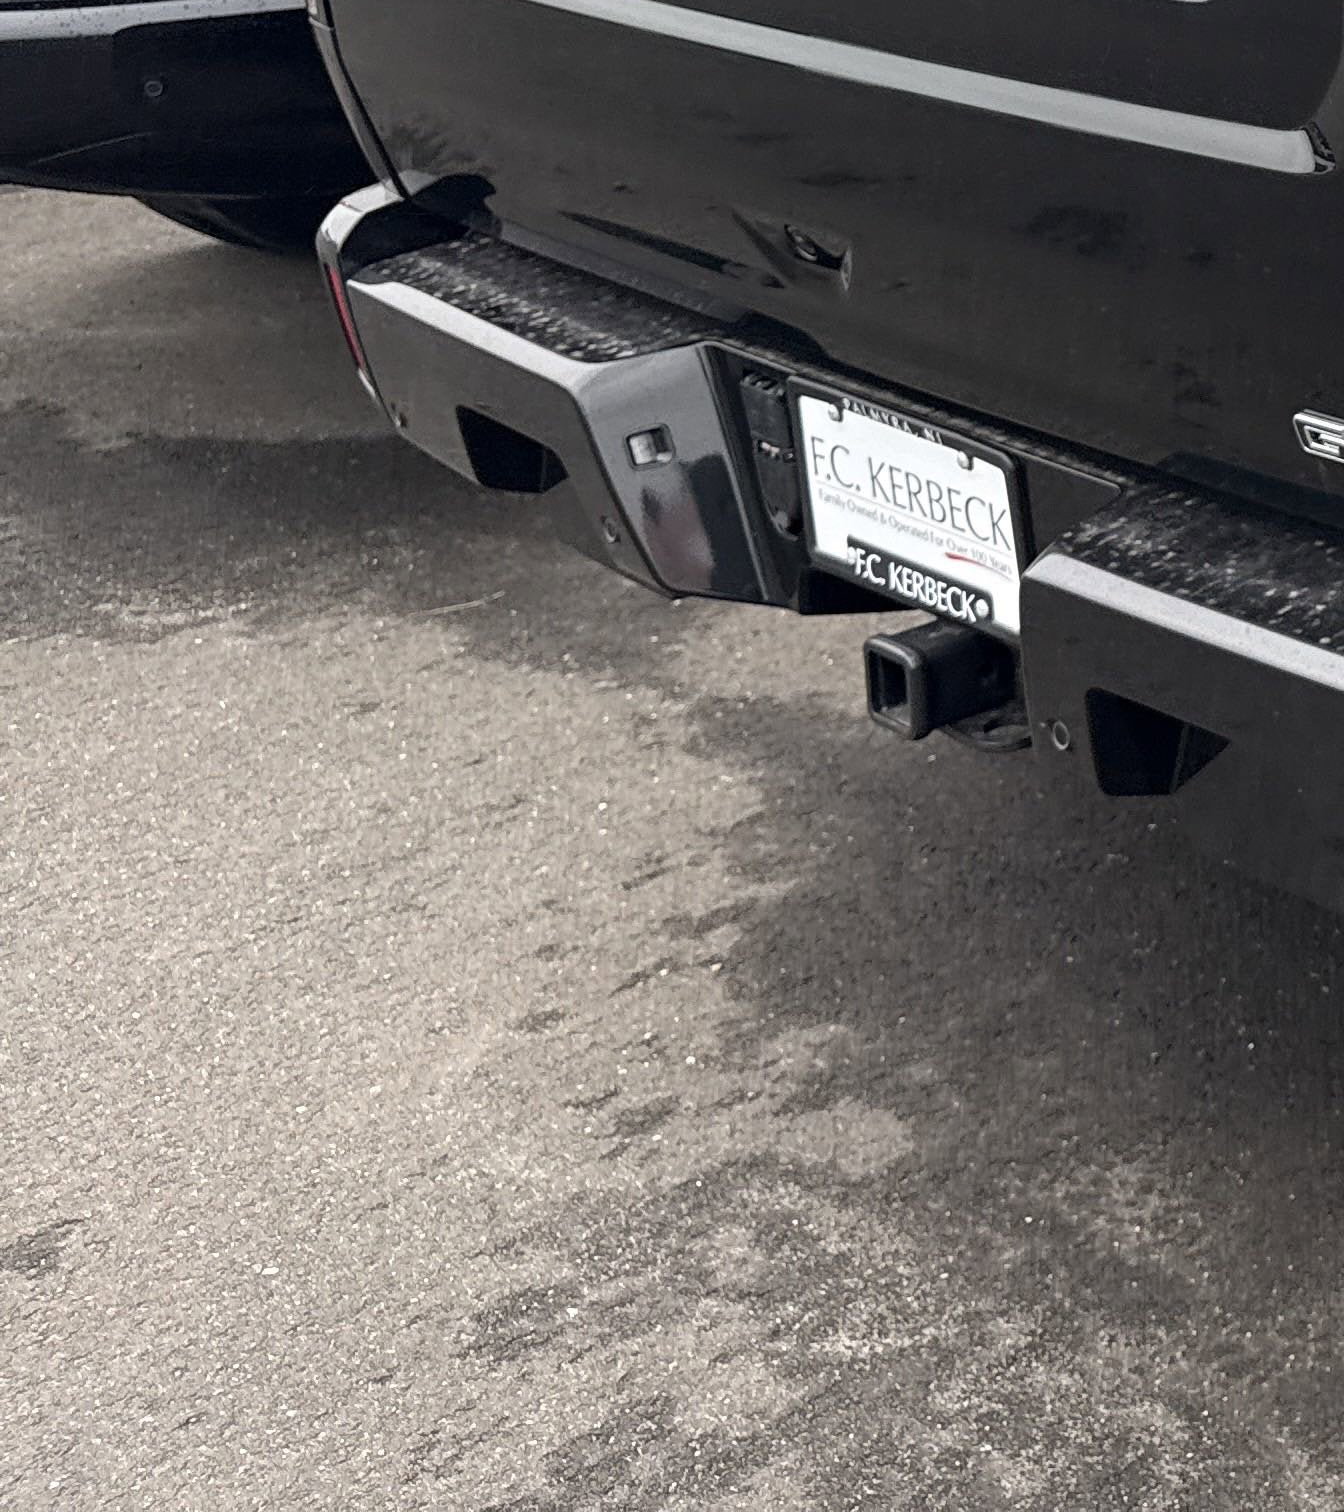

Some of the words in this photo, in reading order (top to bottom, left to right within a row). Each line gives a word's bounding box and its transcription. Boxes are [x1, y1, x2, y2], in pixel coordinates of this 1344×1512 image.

[810, 435, 861, 492] F.C.
[868, 456, 1012, 551] KERBECK
[854, 546, 886, 586] F.C.
[888, 561, 977, 623] KERBECK
